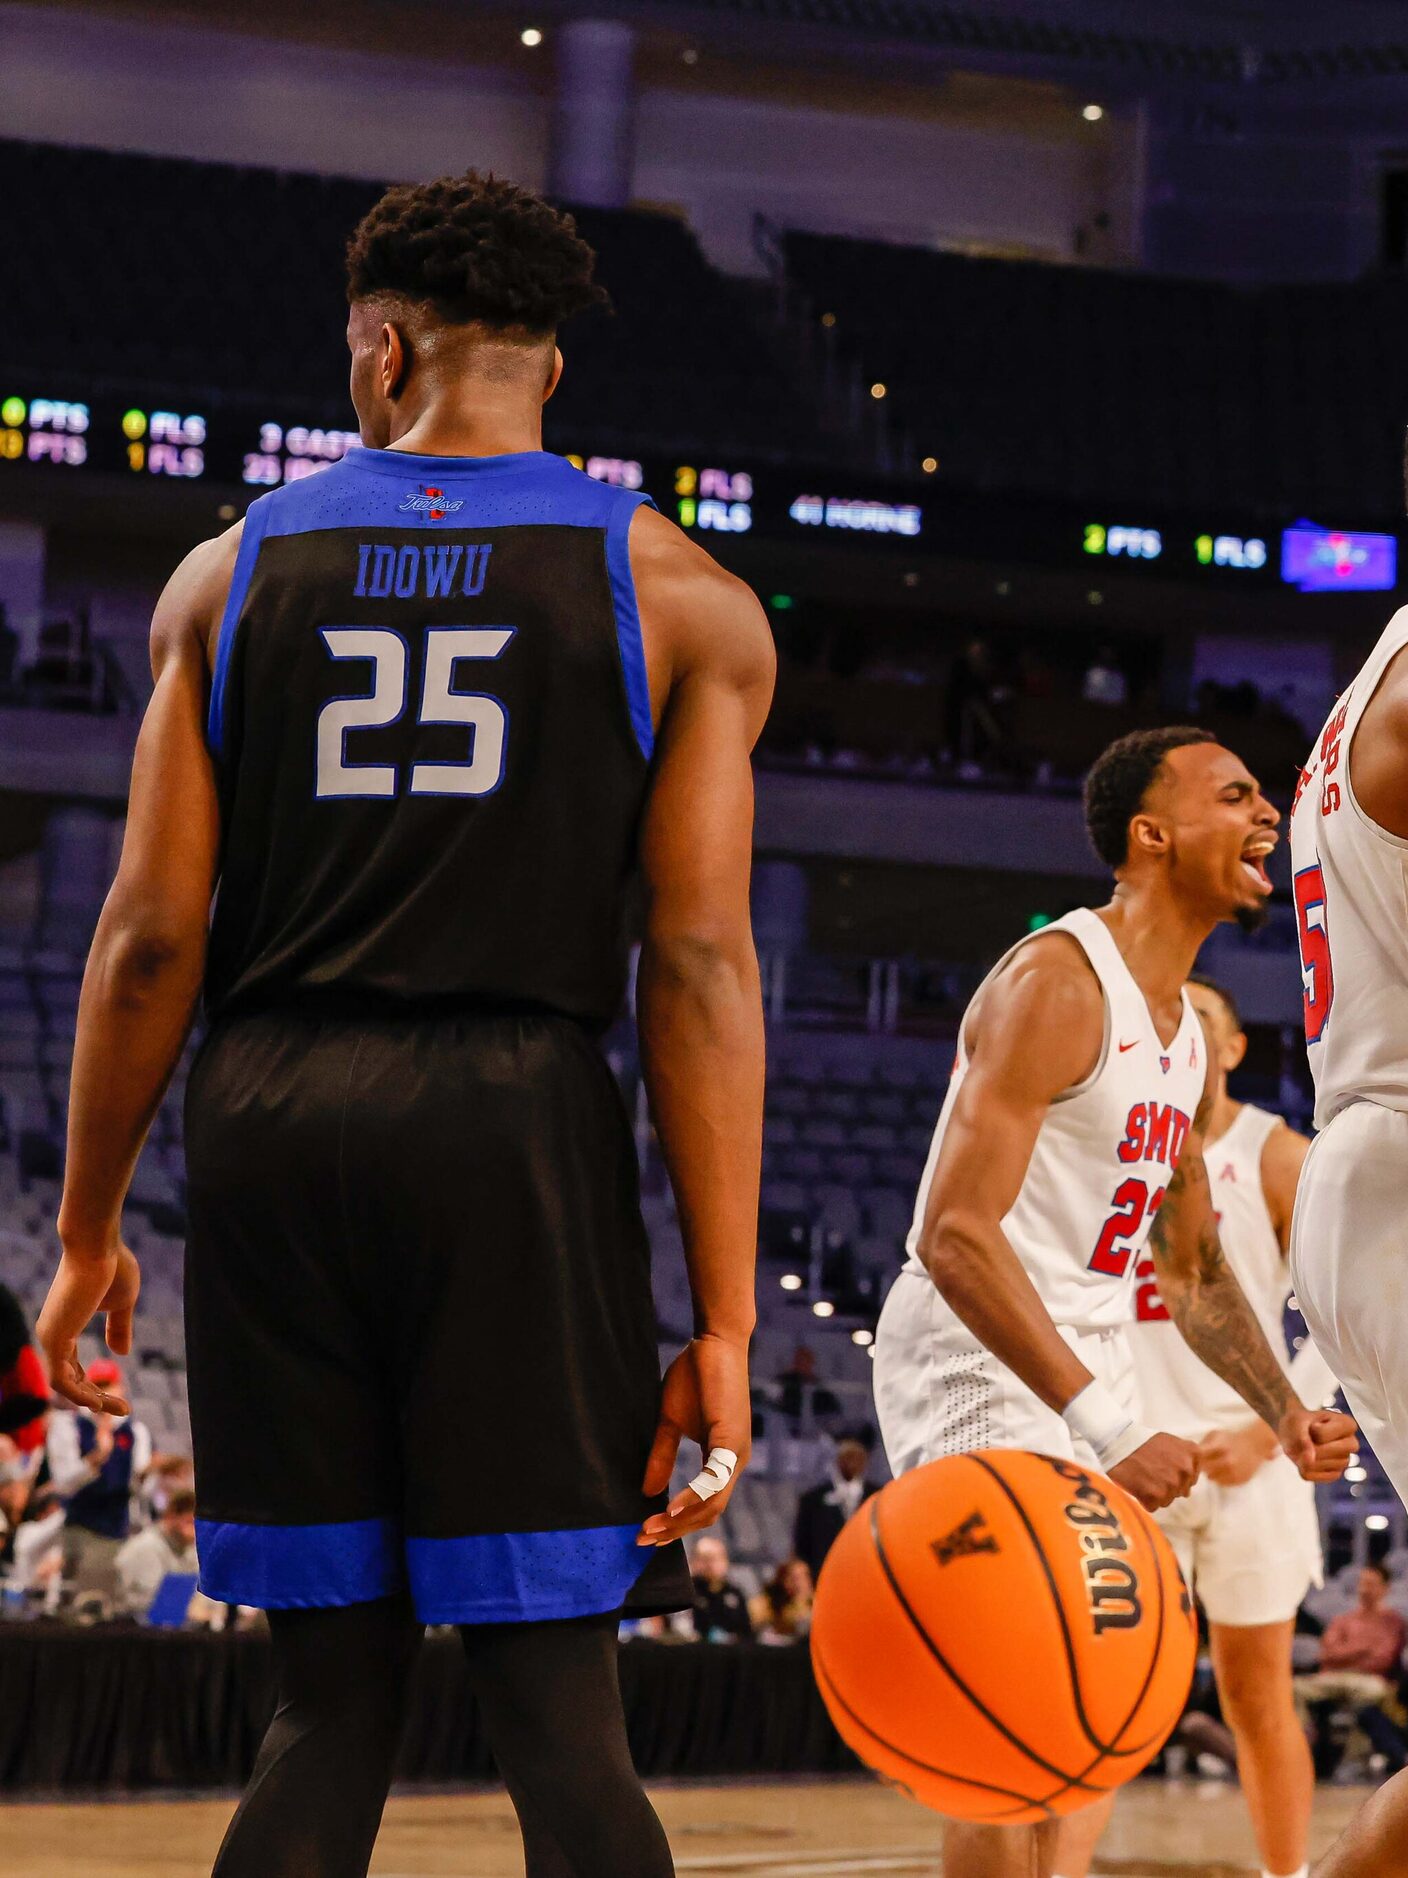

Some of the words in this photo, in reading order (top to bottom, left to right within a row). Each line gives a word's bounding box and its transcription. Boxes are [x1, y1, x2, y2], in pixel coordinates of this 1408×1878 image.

[29, 399, 89, 433] PTS
[150, 412, 206, 446] FLS
[28, 431, 87, 466] PTS
[149, 444, 204, 477] FLS
[700, 468, 753, 501] FLS
[399, 493, 464, 512] Tulsa
[697, 499, 751, 533] FLS
[1083, 524, 1106, 554] 2
[1107, 525, 1162, 558] PTS
[1195, 534, 1213, 564] 1
[1214, 536, 1266, 569] FLS
[353, 544, 492, 598] IDOWU
[315, 626, 518, 800] 25
